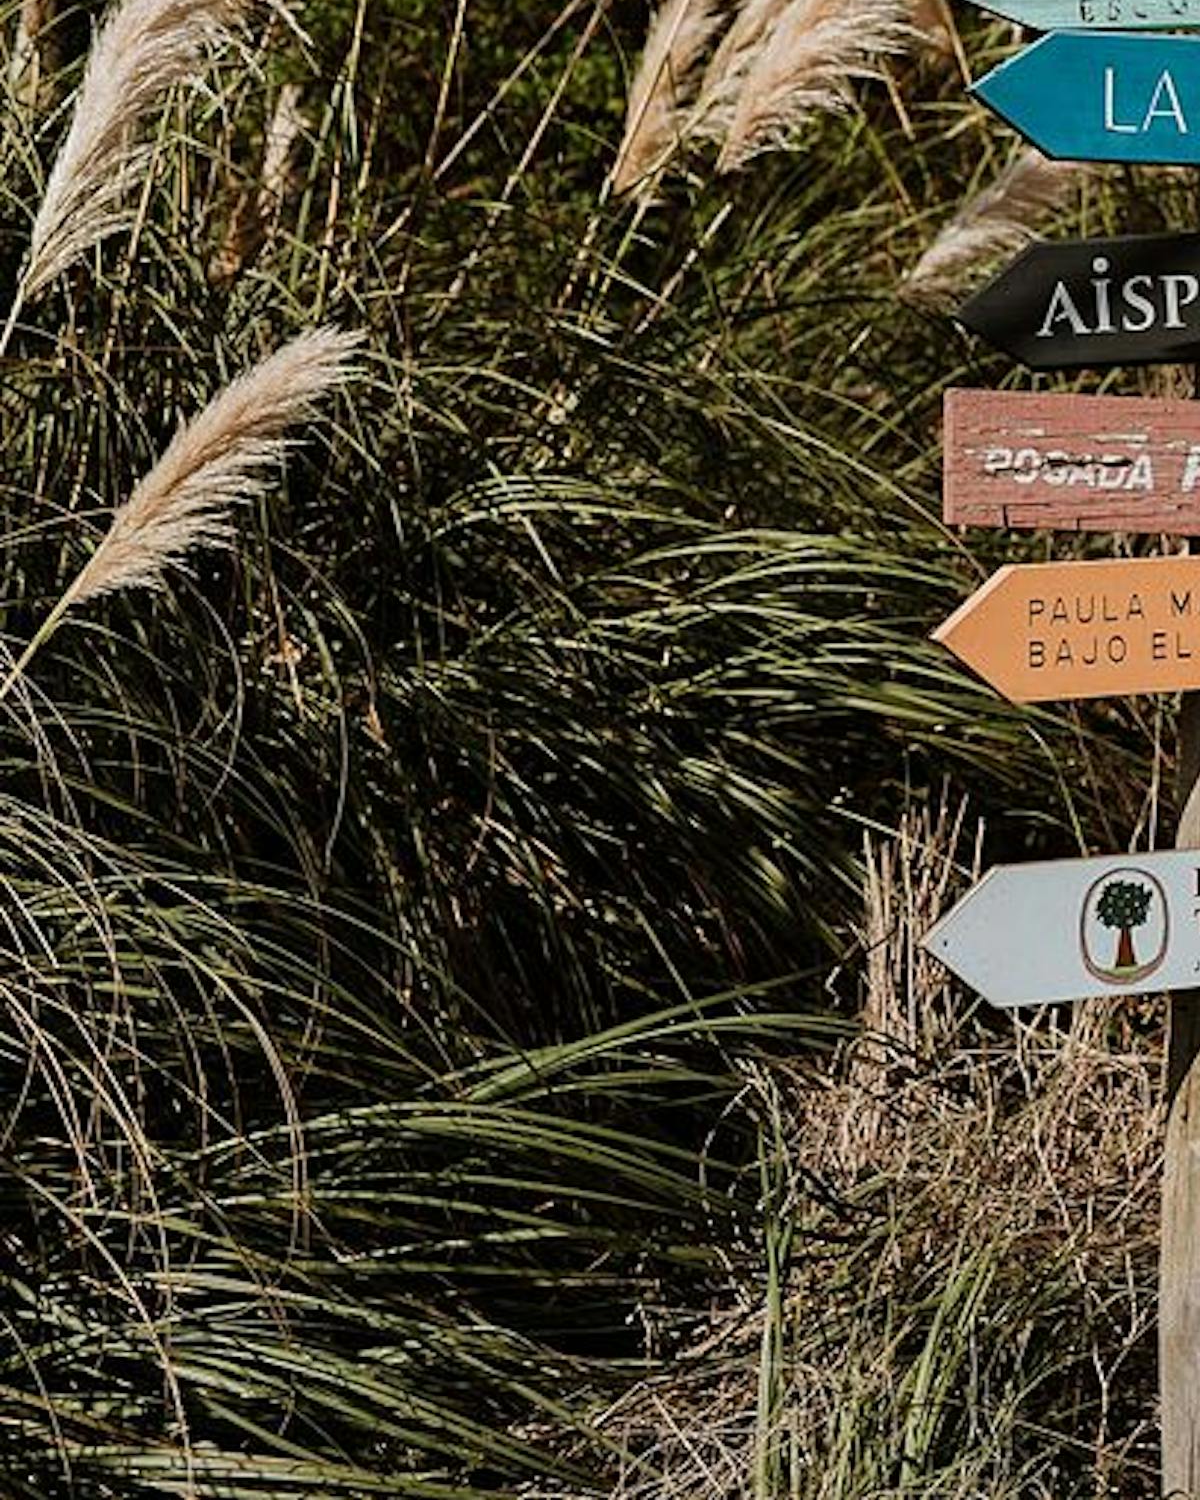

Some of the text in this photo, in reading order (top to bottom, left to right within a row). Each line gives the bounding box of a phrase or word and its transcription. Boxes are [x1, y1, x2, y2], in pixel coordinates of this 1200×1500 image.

[1104, 67, 1187, 134] LA
[984, 448, 1154, 491] POSADA
[1028, 594, 1146, 626] PAULA
[1028, 635, 1128, 668] BAJO
[1151, 632, 1193, 659] EL
